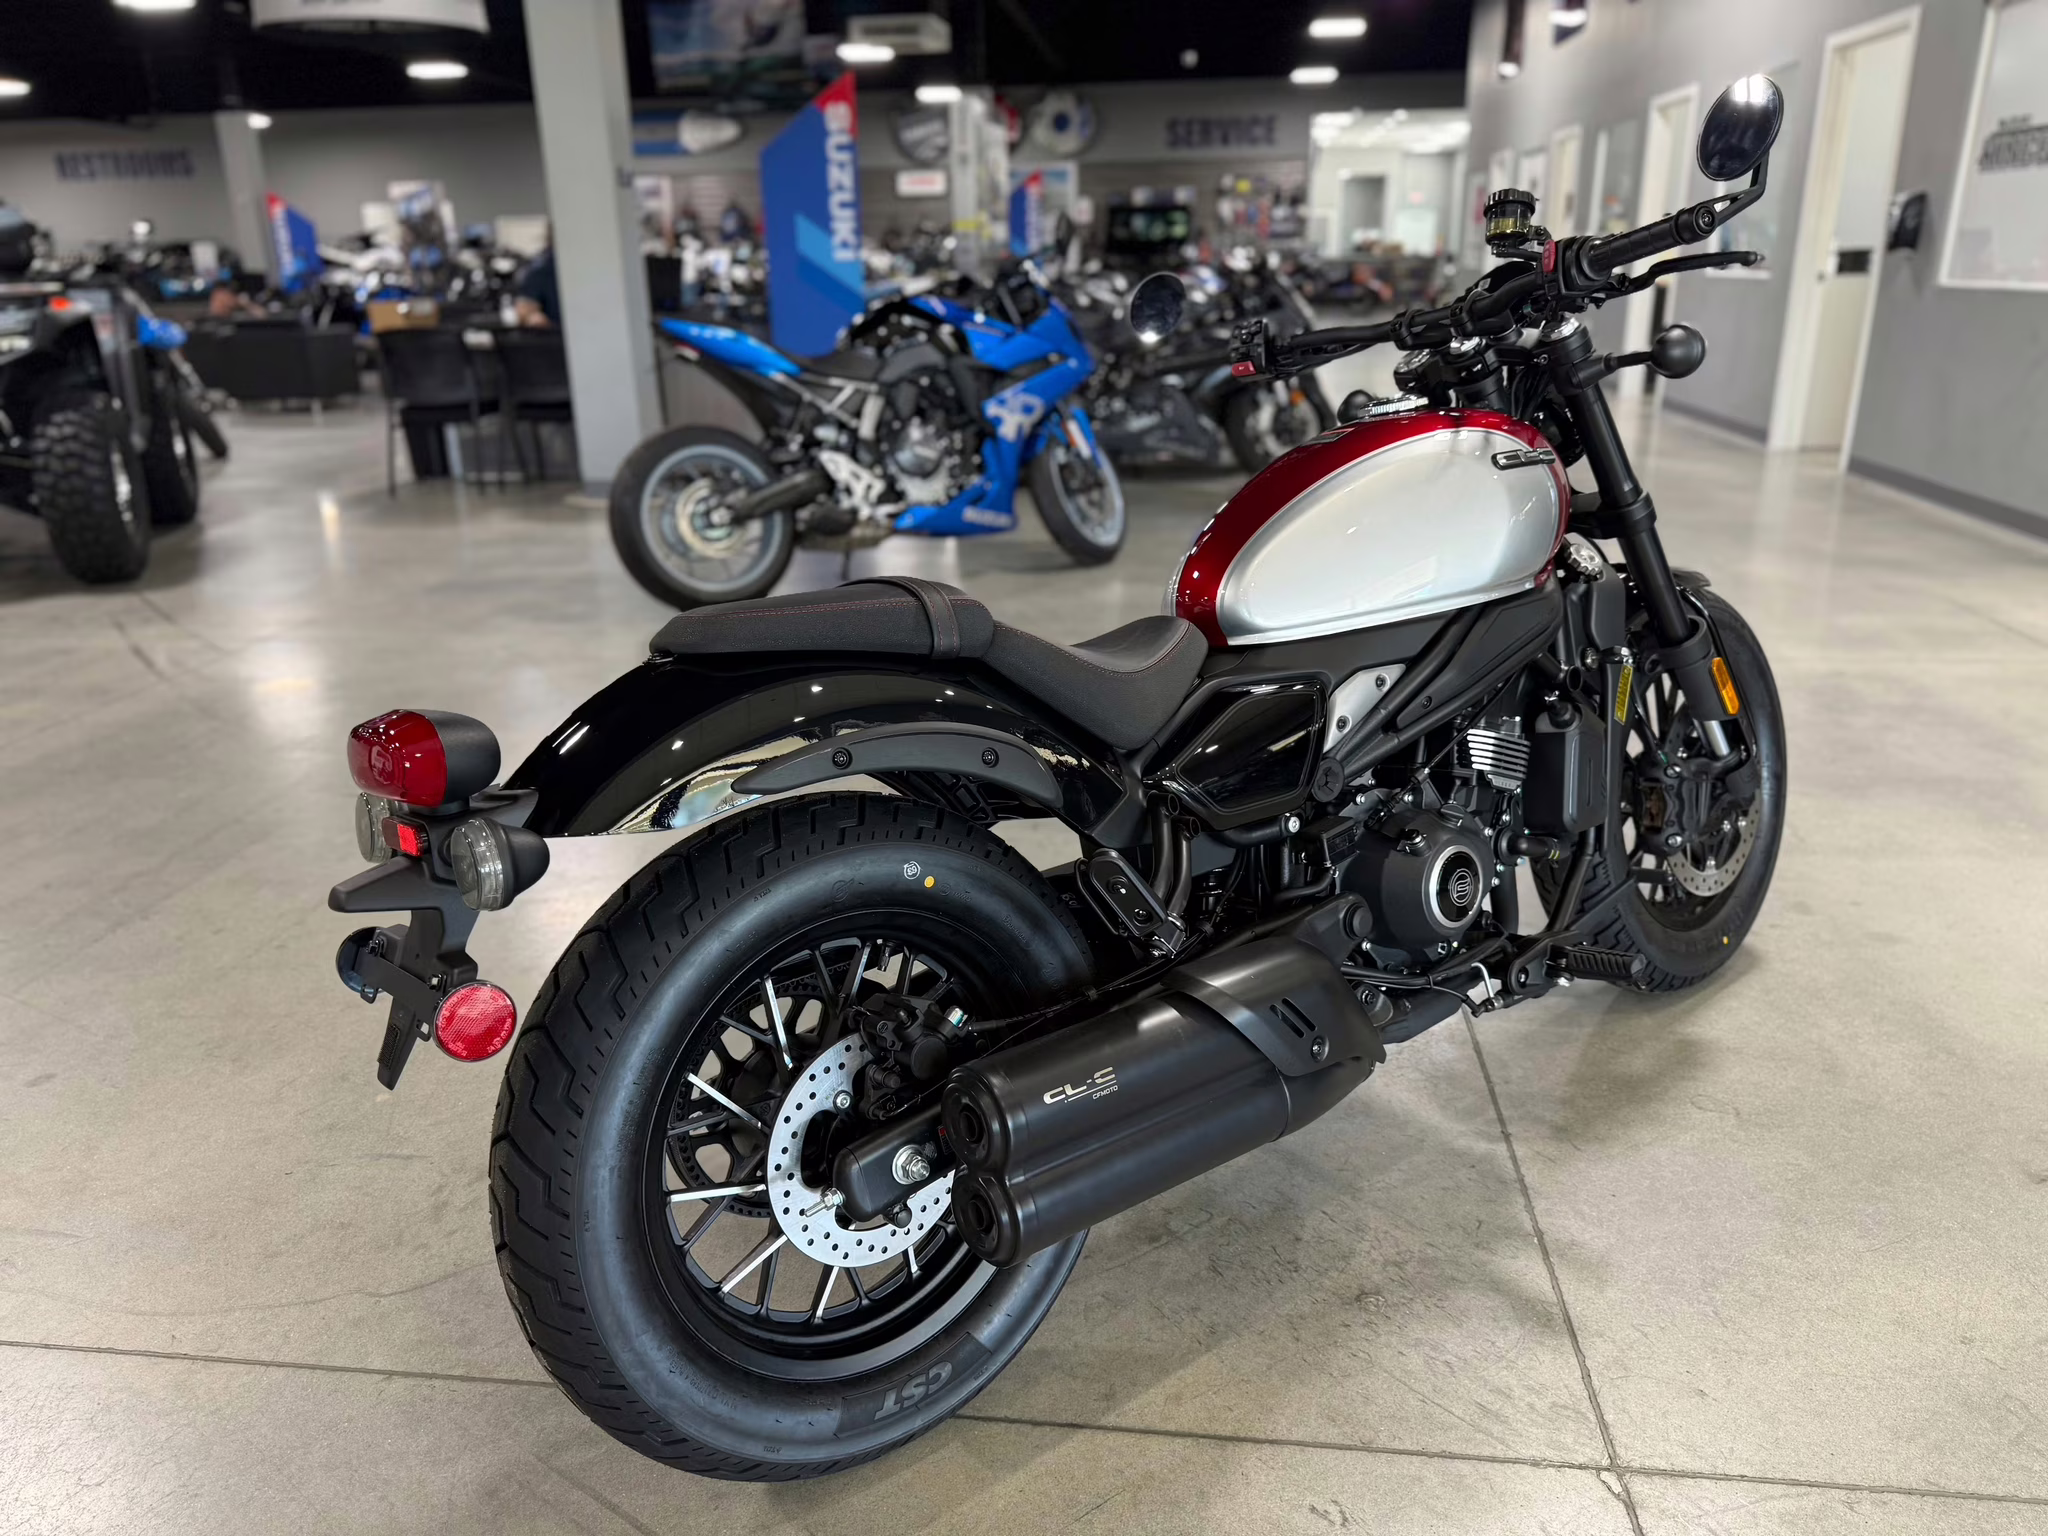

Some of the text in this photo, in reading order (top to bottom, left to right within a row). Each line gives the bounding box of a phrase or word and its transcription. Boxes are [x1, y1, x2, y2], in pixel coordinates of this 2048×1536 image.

[1166, 116, 1276, 150] SERVICE
[824, 100, 857, 262] SUZUKI
[1092, 1085, 1119, 1100] CFMOTO
[873, 1361, 953, 1421] CST
